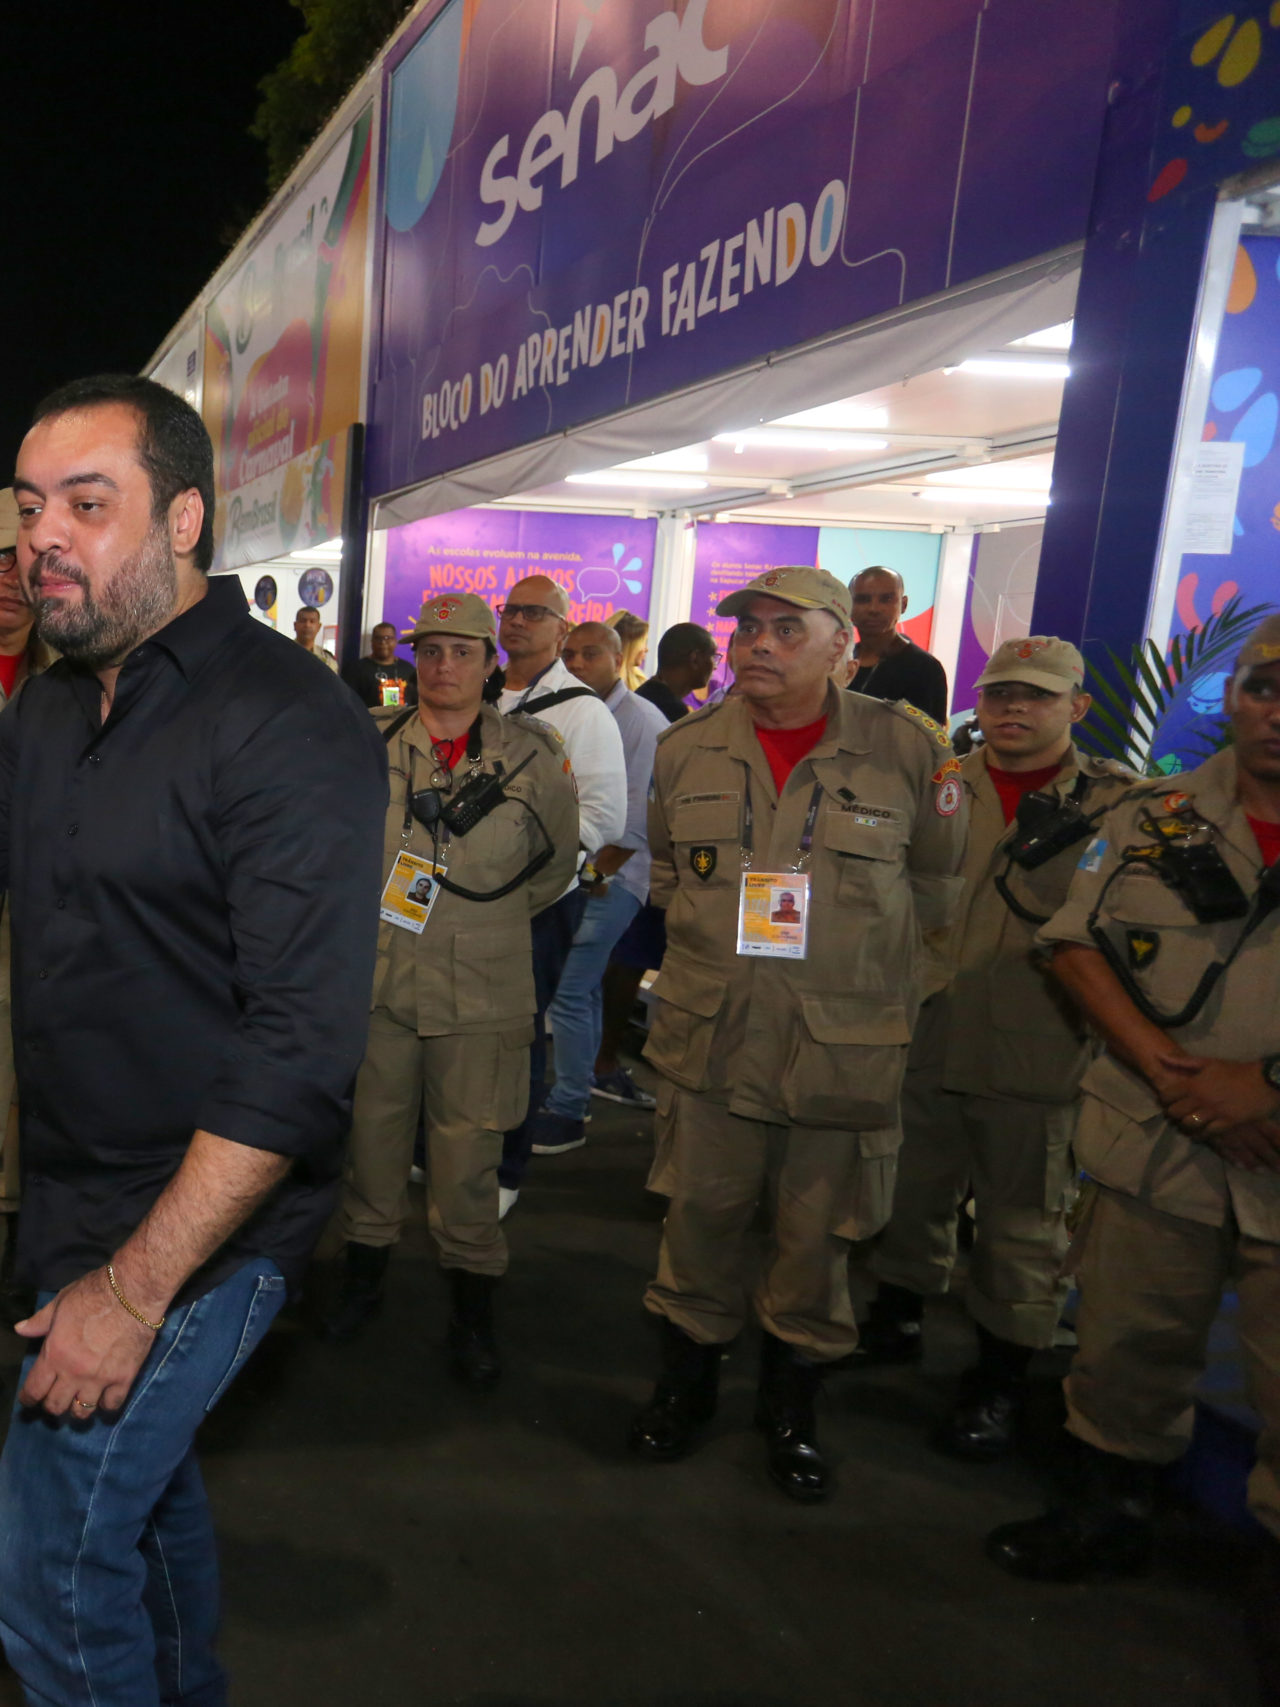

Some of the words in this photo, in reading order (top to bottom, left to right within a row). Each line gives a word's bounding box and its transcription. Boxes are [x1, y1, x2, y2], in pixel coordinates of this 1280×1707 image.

[422, 373, 472, 440] BLOCO
[480, 353, 509, 416] DO
[512, 286, 650, 401] APRENDER
[662, 179, 846, 336] FAZENDO
[443, 547, 480, 557] escolas
[483, 549, 526, 559] evoluem
[527, 551, 539, 560] na
[429, 563, 498, 594] NOSSOS
[504, 565, 576, 593] AOS
[841, 804, 891, 819] MÉDICO
